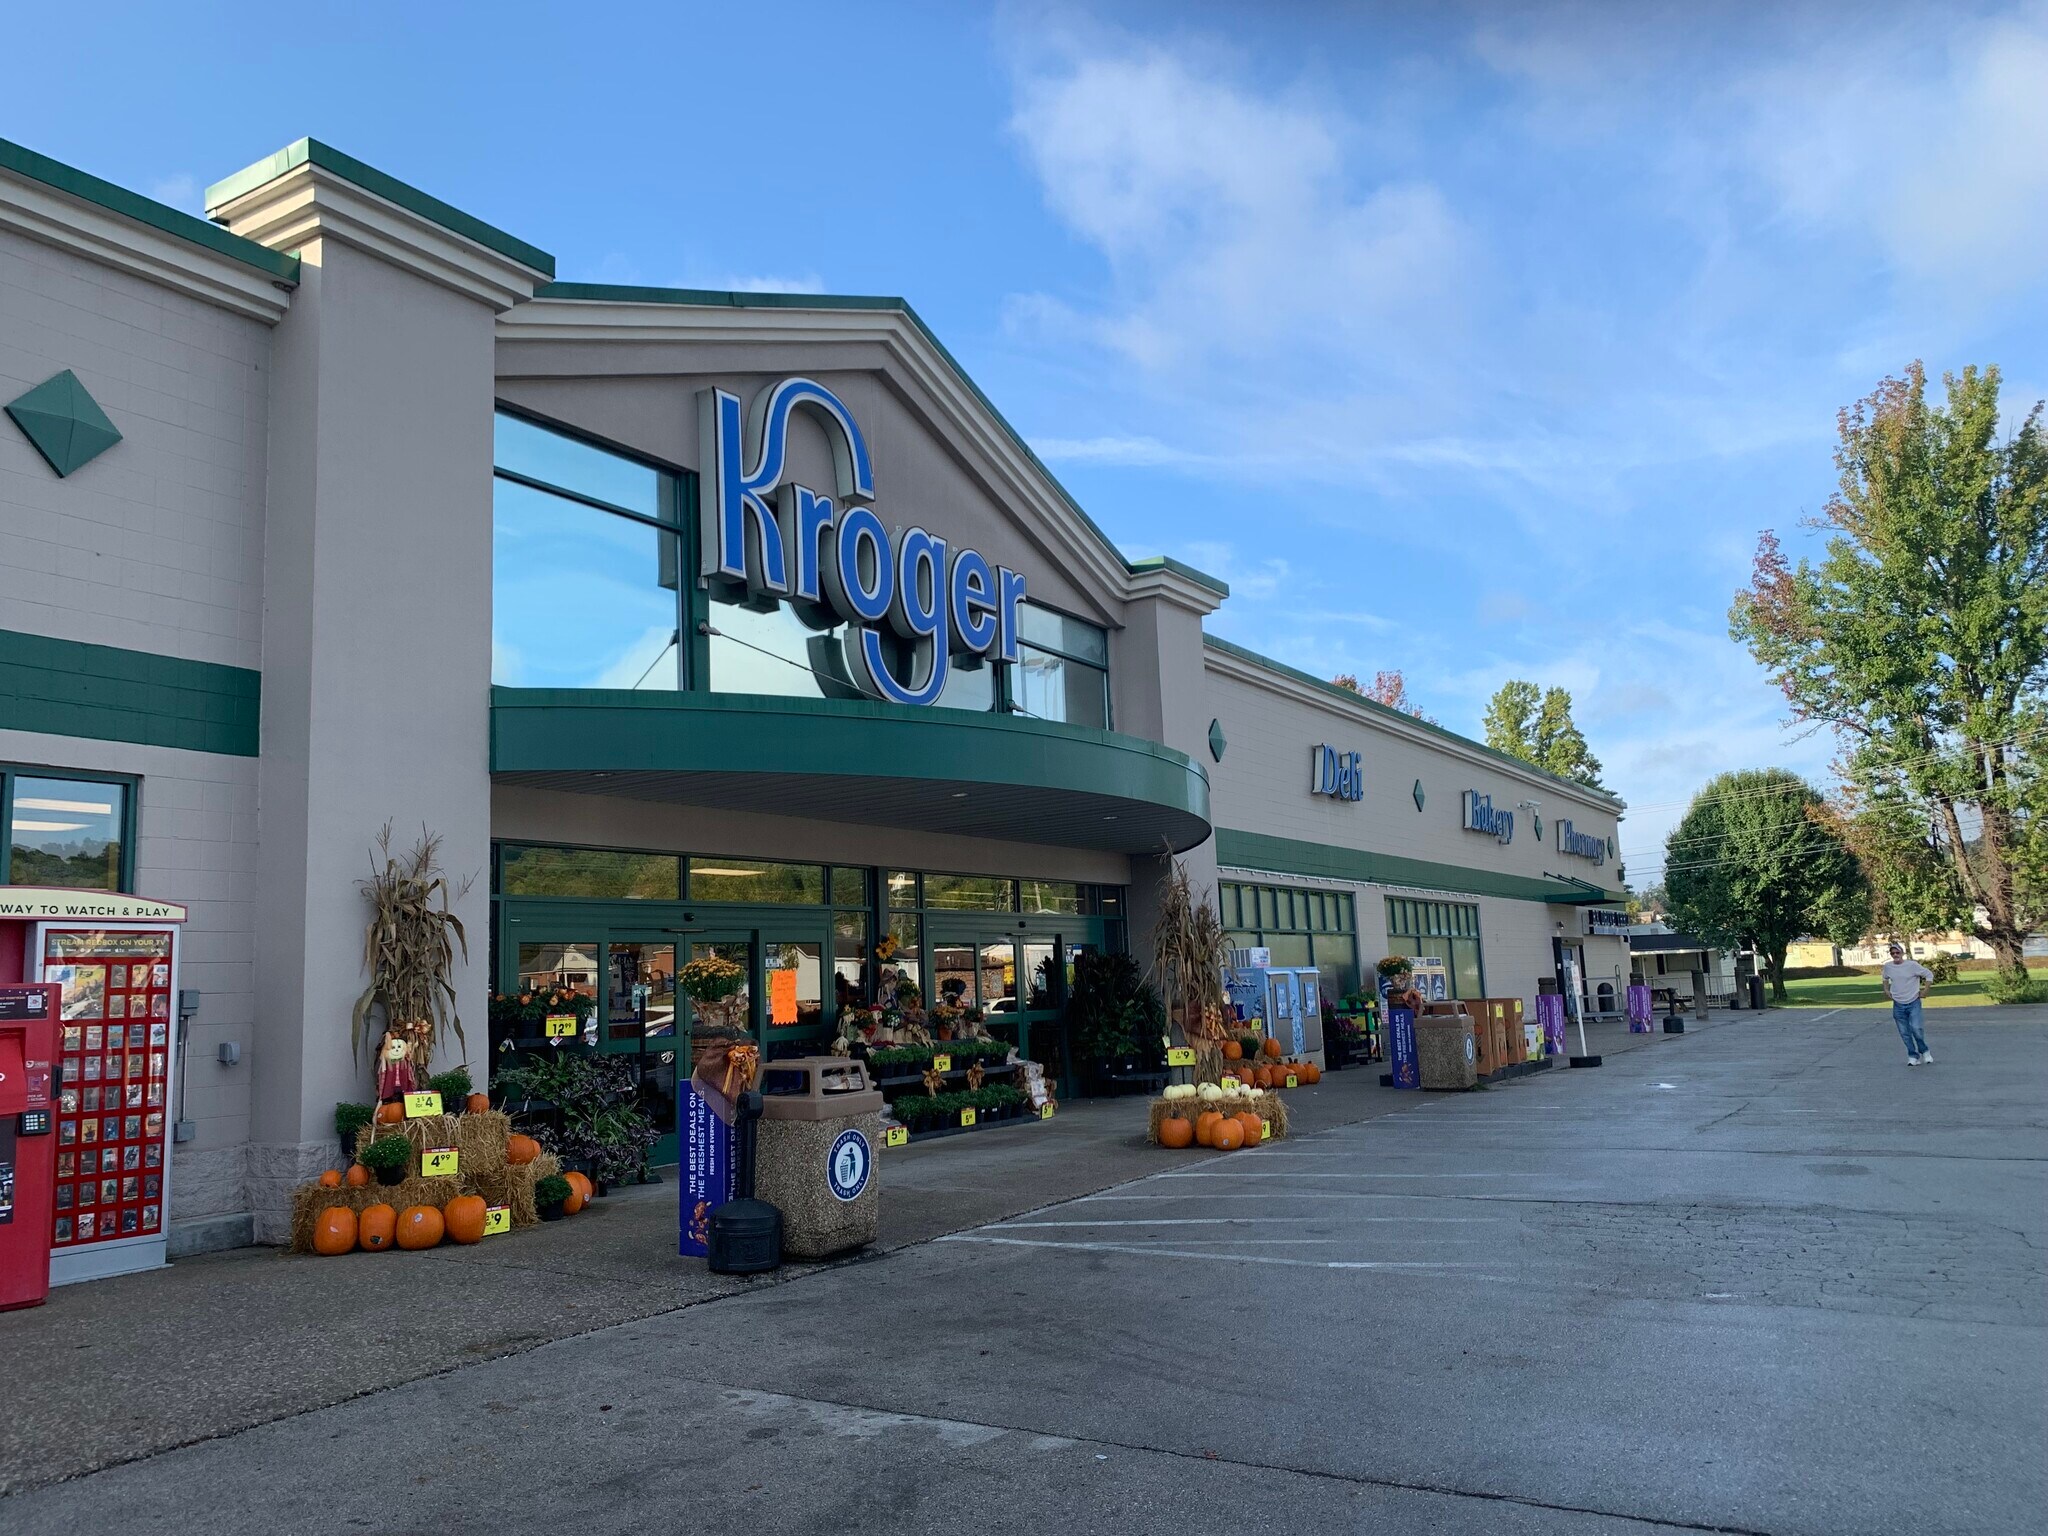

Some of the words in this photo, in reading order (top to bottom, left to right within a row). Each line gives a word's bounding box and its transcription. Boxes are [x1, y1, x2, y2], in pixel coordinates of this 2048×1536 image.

[698, 377, 1027, 706] Kroger
[1312, 743, 1363, 801] Deli
[1463, 789, 1513, 844] Bakery
[0, 904, 33, 914] WAY
[40, 905, 59, 915] TO
[66, 906, 115, 916] WATCH
[122, 907, 130, 916] &
[136, 907, 170, 917] PLAY
[690, 1092, 696, 1108] ON
[834, 1134, 851, 1153] TRASH
[852, 1134, 865, 1148] ONLY
[833, 1182, 851, 1196] TRASH
[852, 1176, 865, 1193] ONLY
